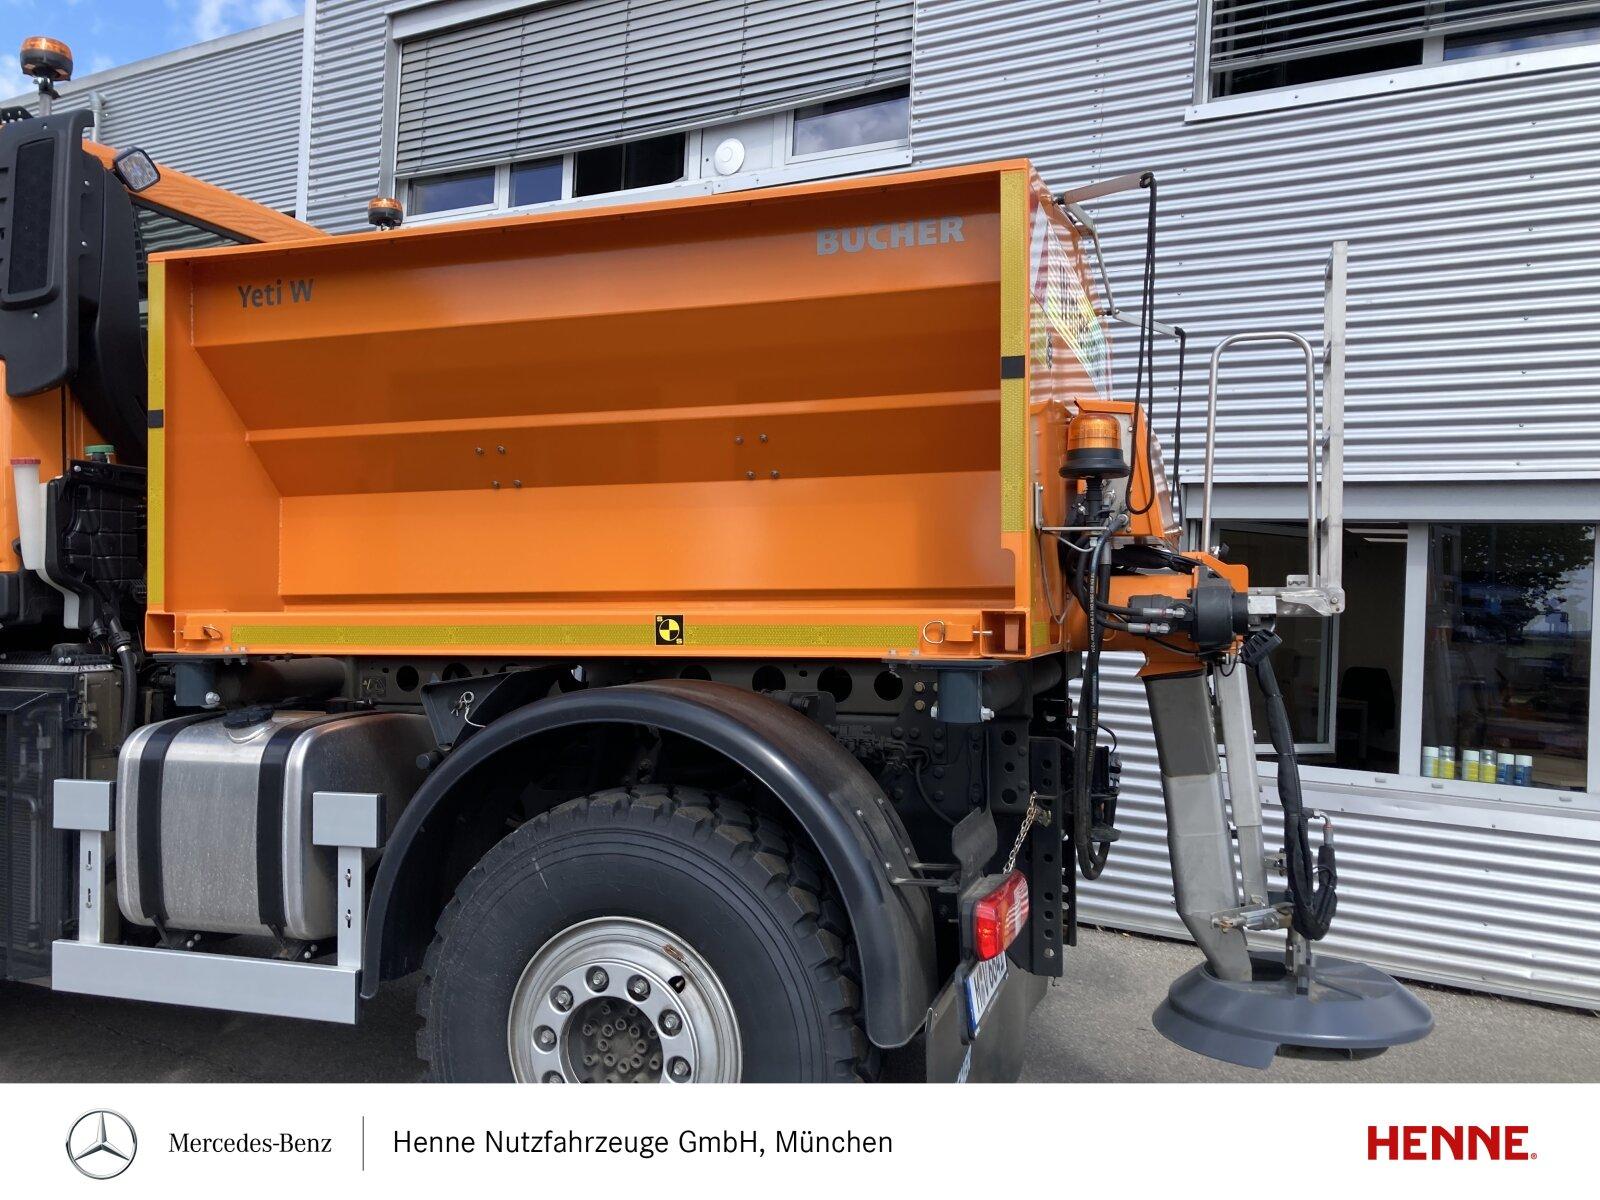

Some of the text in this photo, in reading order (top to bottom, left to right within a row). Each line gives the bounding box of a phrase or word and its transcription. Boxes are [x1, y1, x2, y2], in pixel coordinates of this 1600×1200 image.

[816, 216, 965, 256] BUCHER
[237, 278, 315, 308] Yeti W
